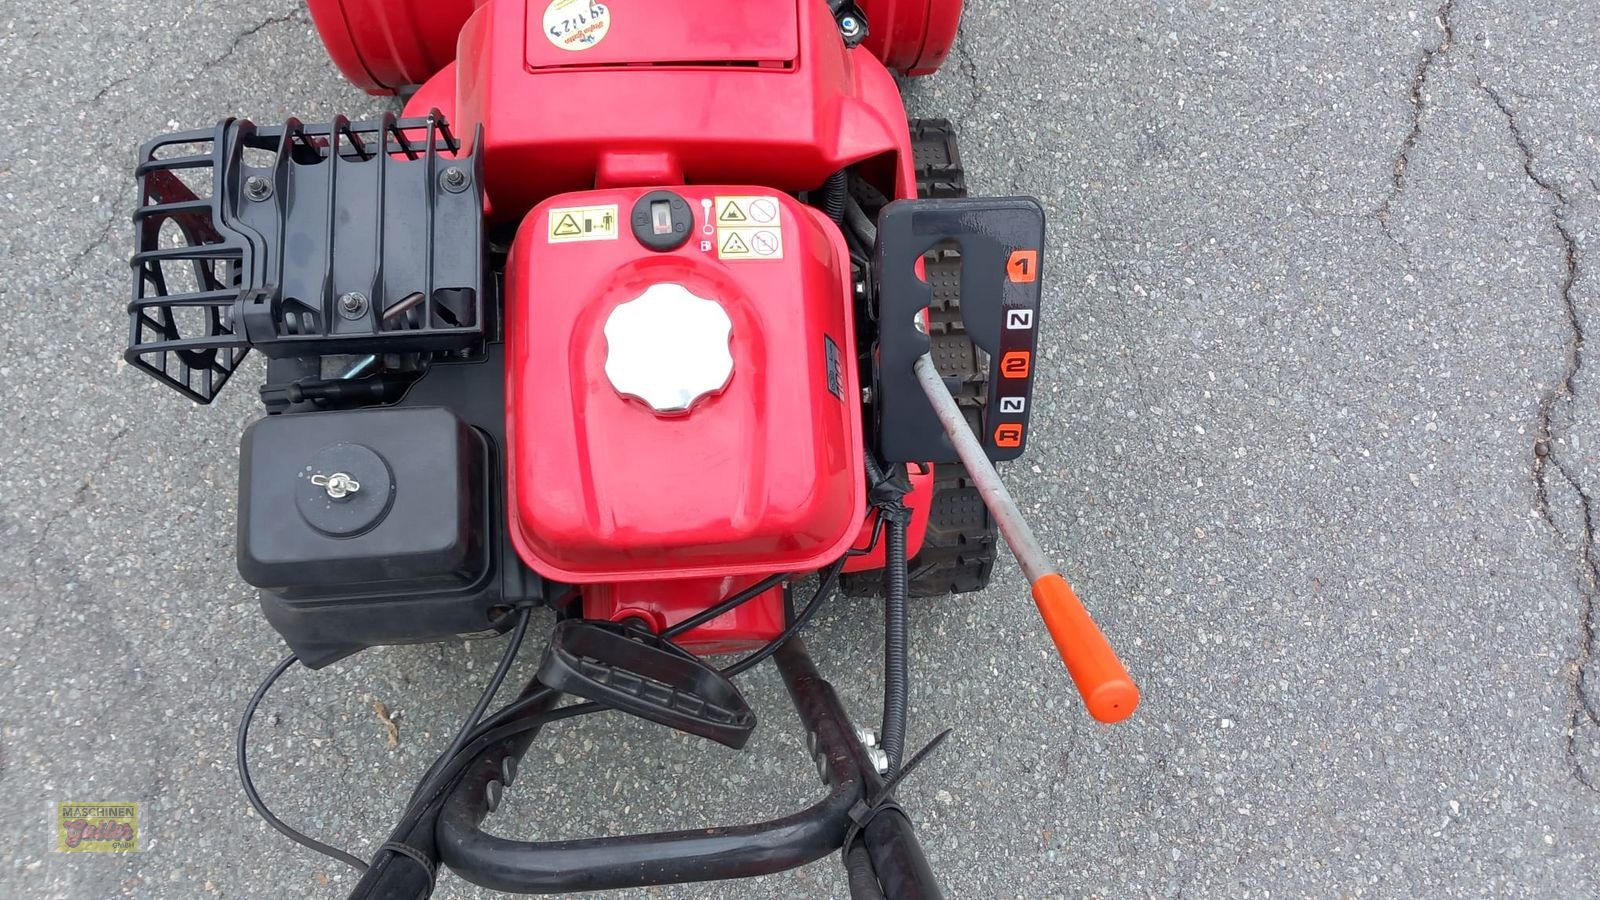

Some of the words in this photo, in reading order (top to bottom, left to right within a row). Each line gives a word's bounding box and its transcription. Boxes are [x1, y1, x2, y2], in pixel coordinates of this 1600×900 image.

[1015, 258, 1028, 275] 1
[1011, 313, 1029, 326] N
[1006, 358, 1027, 372] 2
[1004, 400, 1021, 409] N
[999, 430, 1019, 441] R
